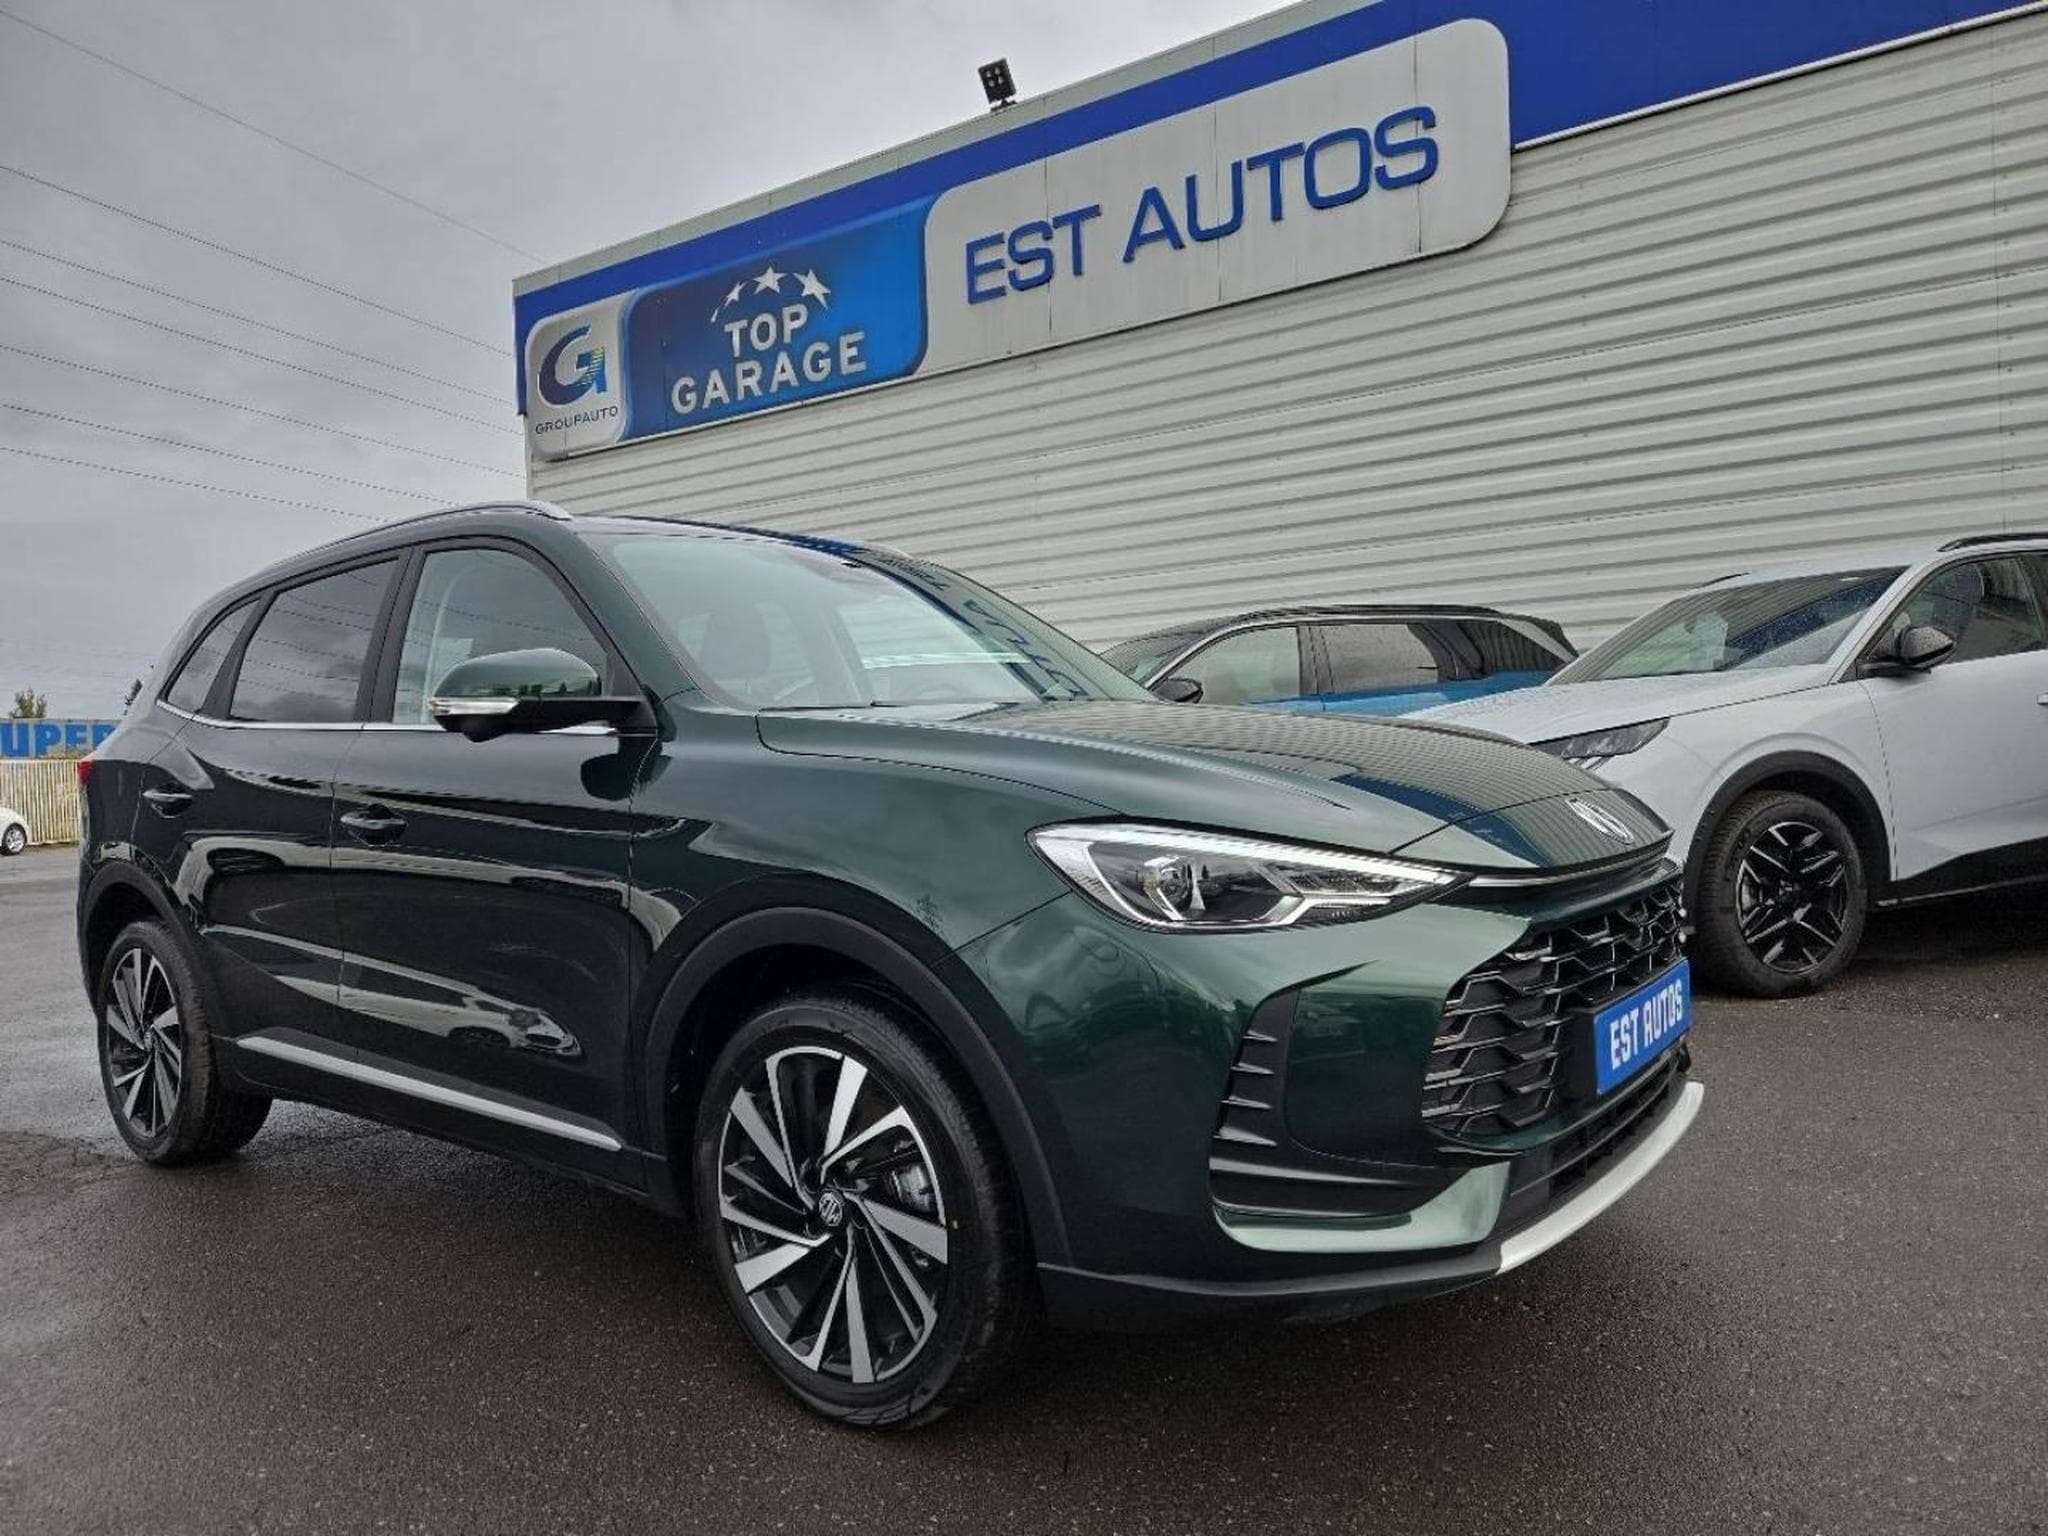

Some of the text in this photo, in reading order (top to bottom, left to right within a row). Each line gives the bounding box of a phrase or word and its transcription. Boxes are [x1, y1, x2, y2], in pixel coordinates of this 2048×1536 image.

[965, 106, 1438, 304] EST AUTOS
[724, 304, 809, 358] TOP
[671, 332, 867, 415] GARAGE
[535, 405, 618, 434] GROUPAUTO
[1610, 978, 1682, 1071] EST AUTOS
